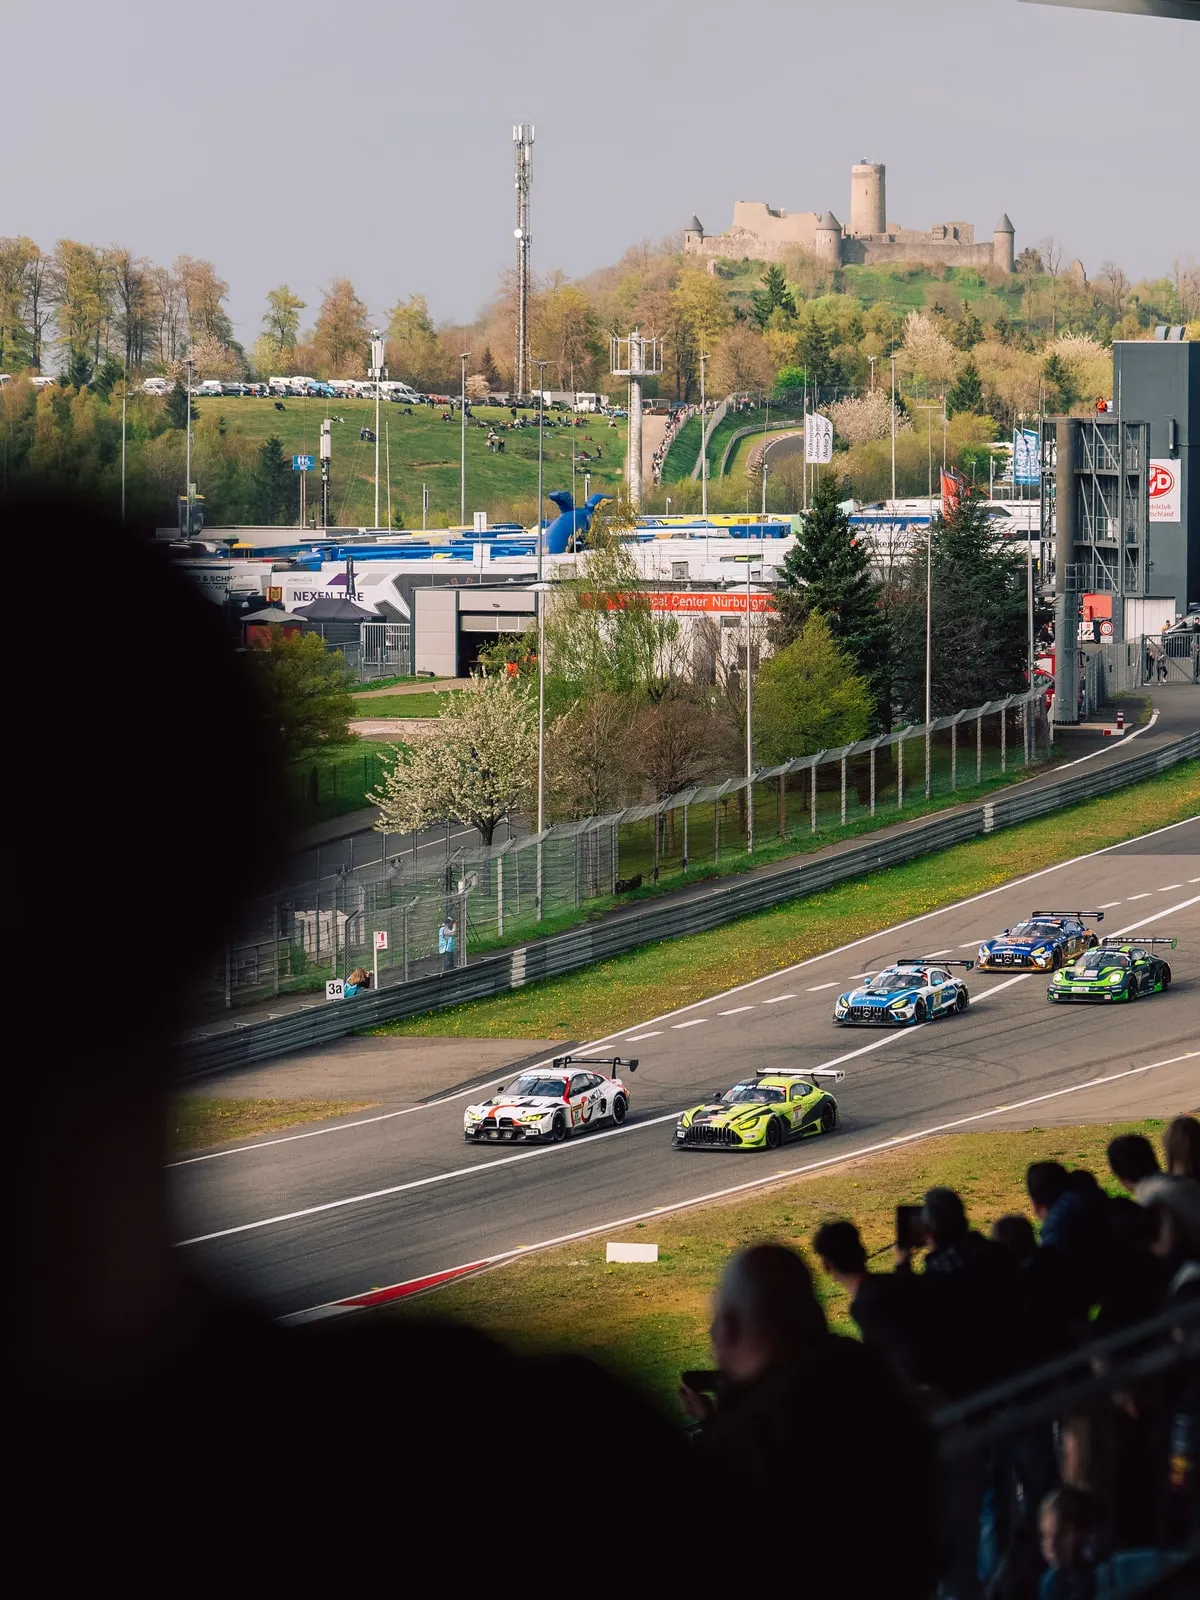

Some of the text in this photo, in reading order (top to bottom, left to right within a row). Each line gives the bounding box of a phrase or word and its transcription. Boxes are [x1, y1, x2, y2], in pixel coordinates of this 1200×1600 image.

[294, 591, 334, 602] NEXEN
[671, 596, 708, 607] Center
[328, 983, 342, 994] 3a
